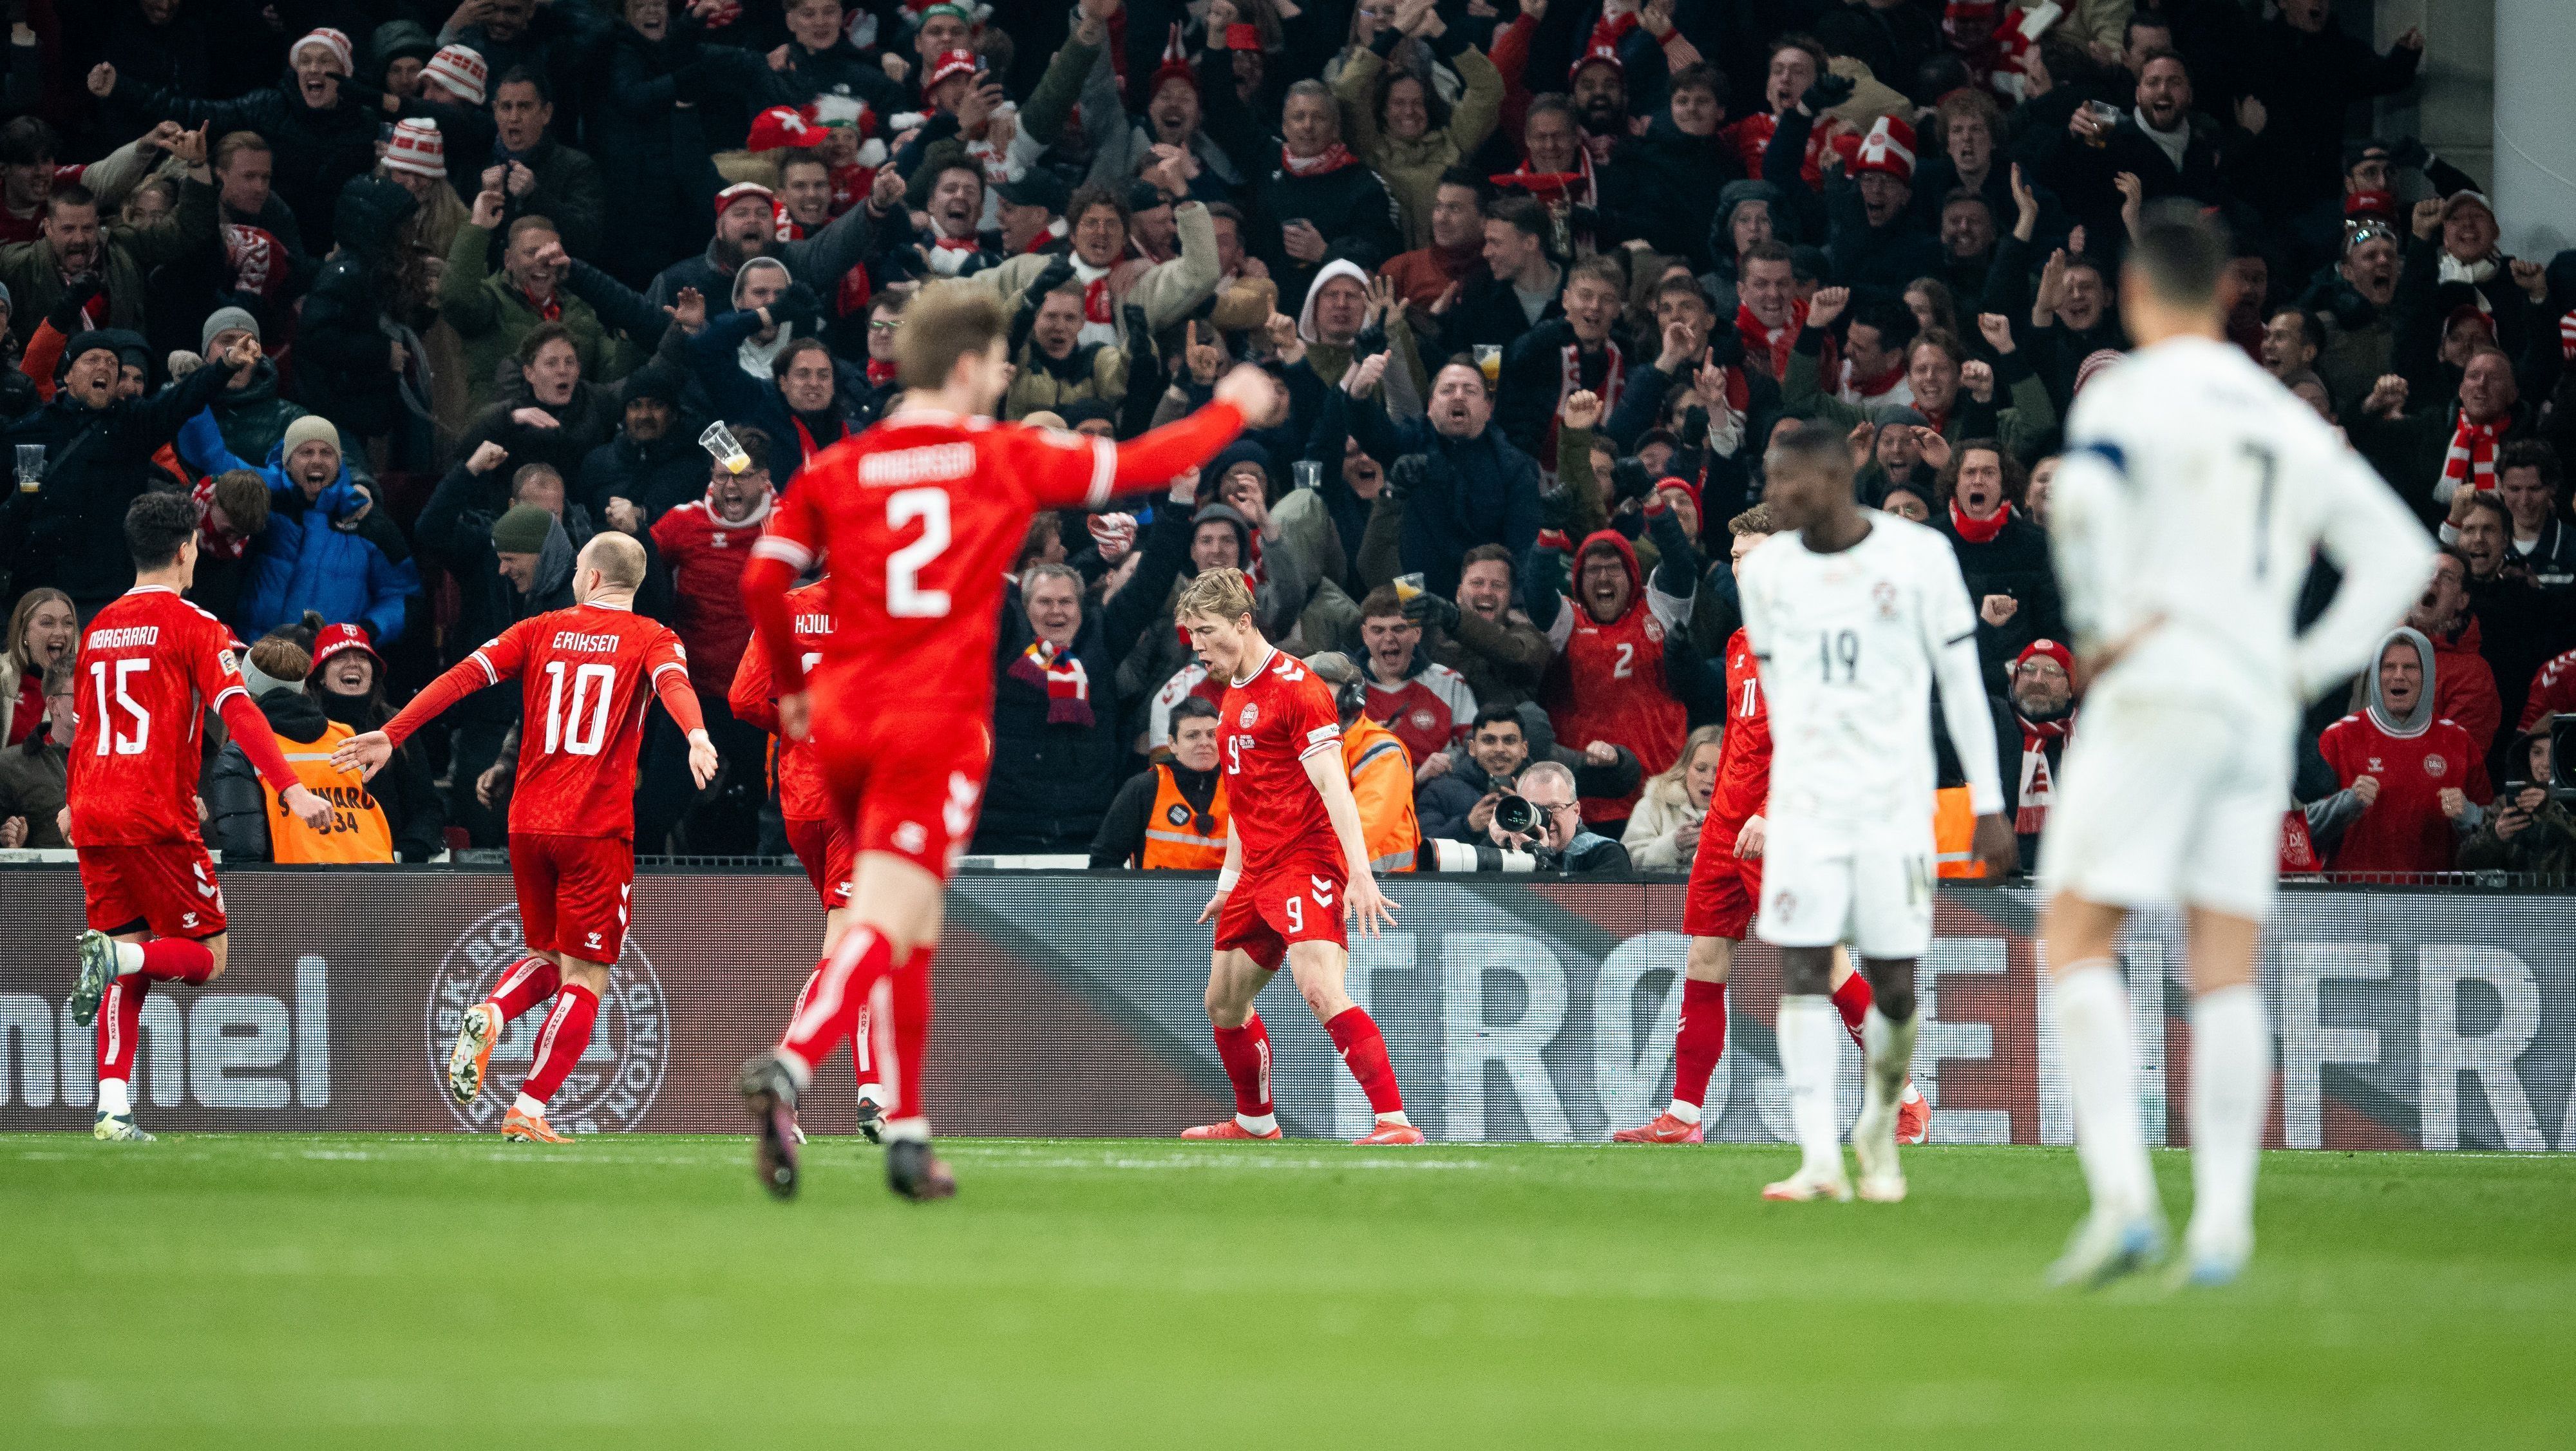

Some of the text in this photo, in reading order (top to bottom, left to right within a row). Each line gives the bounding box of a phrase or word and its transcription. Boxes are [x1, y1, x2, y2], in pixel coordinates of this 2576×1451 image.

[2233, 437, 2278, 583] 7
[886, 486, 952, 618] 2
[88, 626, 158, 650] NØRGAARD
[552, 631, 620, 653] ERIKSEN
[795, 614, 838, 634] HJUL
[1613, 643, 1634, 679] 2
[1819, 629, 1859, 685] 19
[90, 658, 150, 756] 15
[544, 661, 616, 756] 10
[1739, 678, 1756, 717] 11
[1228, 735, 1240, 775] 9
[278, 786, 375, 817] SWARD
[319, 811, 359, 835] 34
[1286, 896, 1303, 933] 9
[542, 1007, 565, 1048] DANMARK
[2281, 942, 2576, 1152] FR
